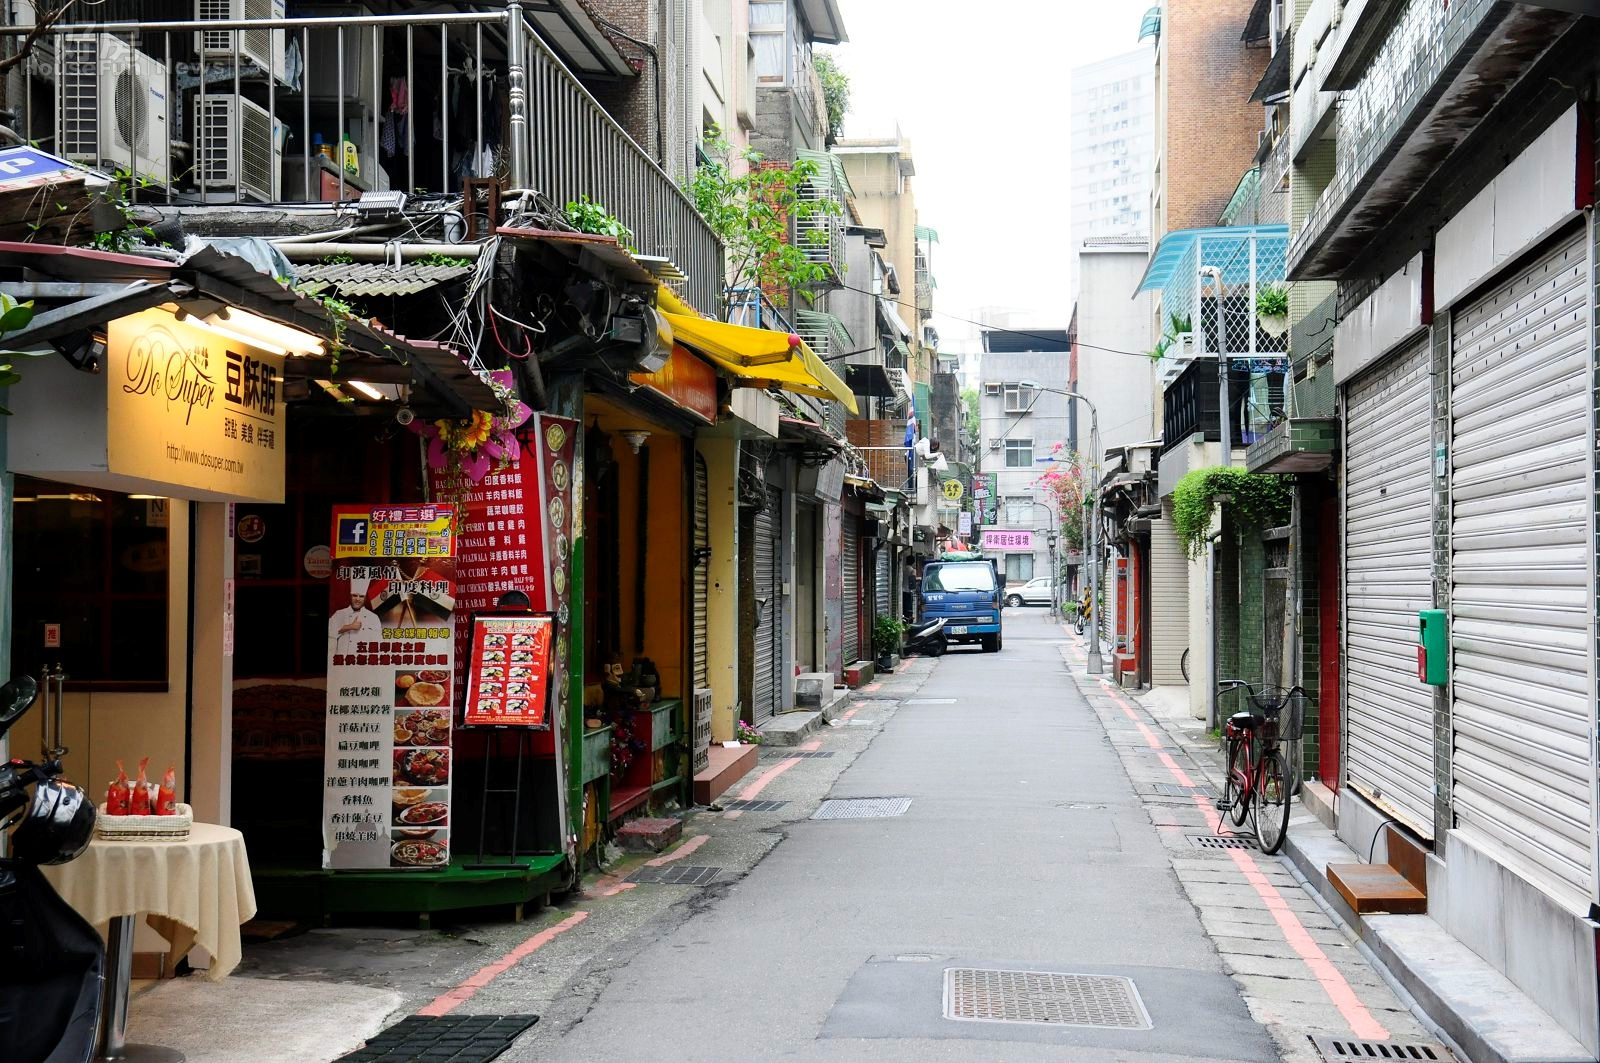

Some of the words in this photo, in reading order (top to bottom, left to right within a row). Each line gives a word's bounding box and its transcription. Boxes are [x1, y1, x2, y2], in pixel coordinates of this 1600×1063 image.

[164, 350, 217, 426] Super
[241, 422, 254, 444] 美食
[166, 441, 244, 475] http://www.dosuper.com.tw
[486, 488, 523, 501] 羊肉香料飯
[372, 509, 453, 522] 好禮三選一
[465, 537, 487, 548] MASALA
[986, 534, 1029, 546] 捍衛居住環境
[336, 566, 398, 580] 印渡風情
[468, 567, 489, 578] CURRY
[388, 581, 449, 595] 印度料理
[465, 598, 487, 609] KABAB
[338, 722, 381, 733] 洋菇青豆
[338, 740, 380, 751] 扁豆咖哩
[337, 758, 379, 769] 雞肉咖哩
[342, 794, 373, 805] 香料魚
[335, 831, 377, 842] 串燒羊肉
